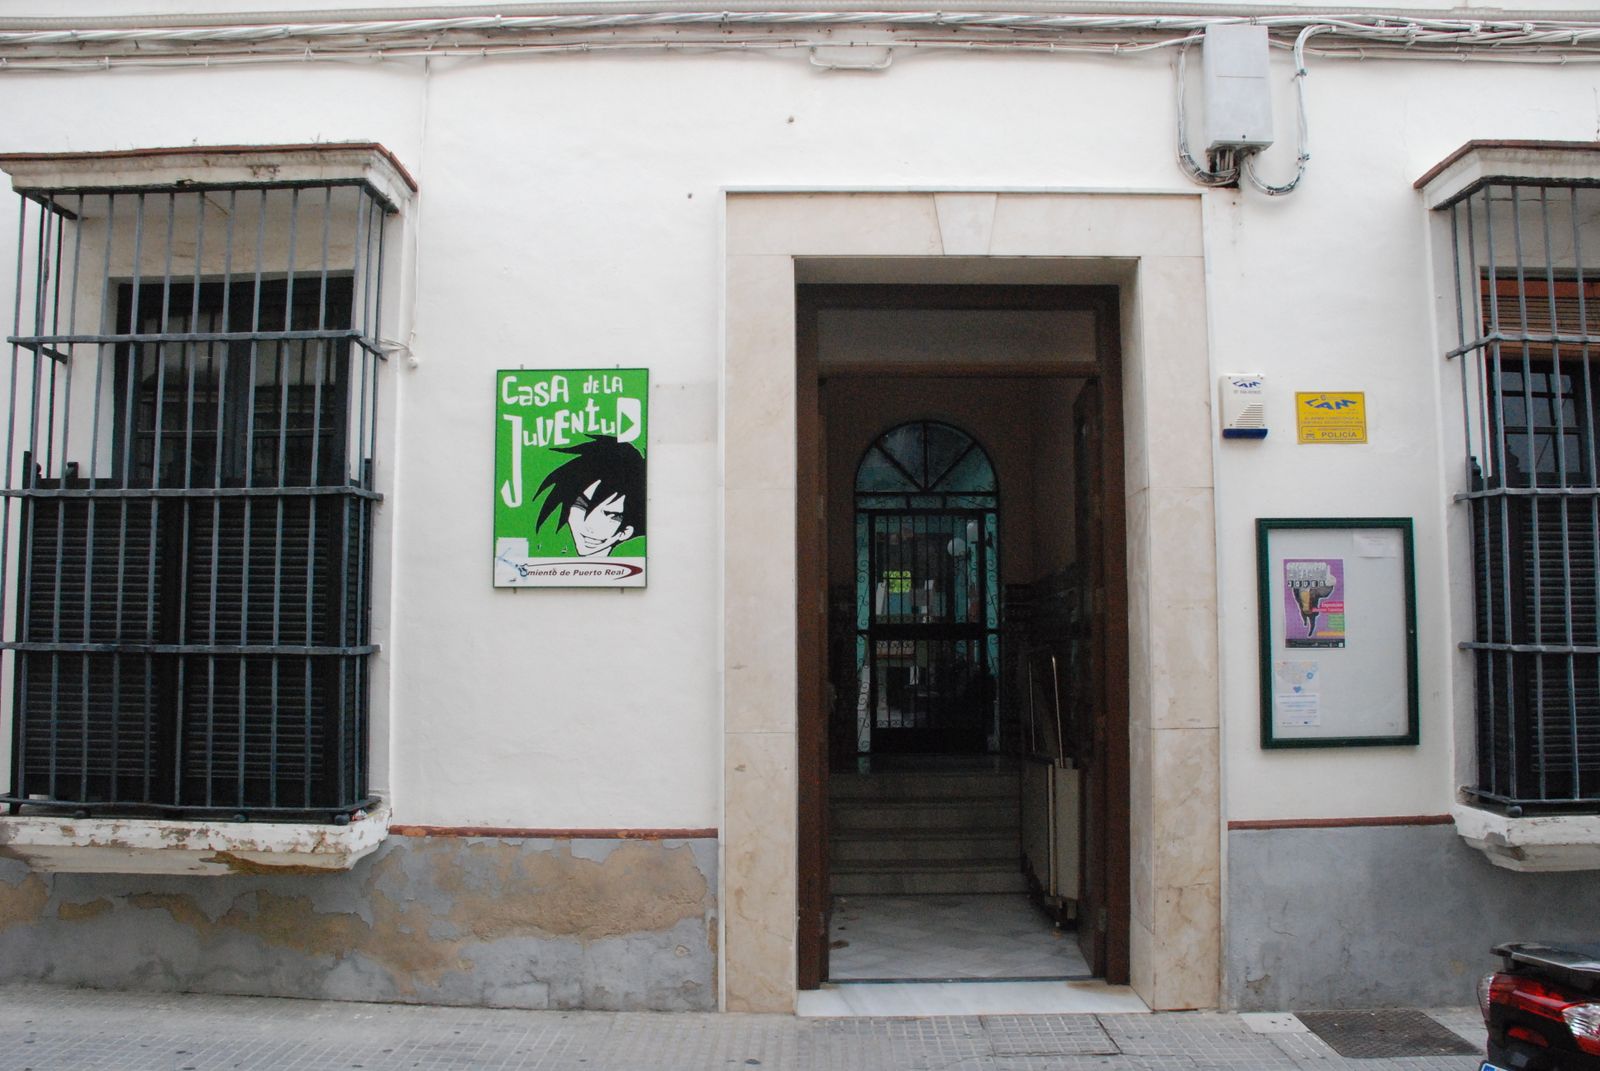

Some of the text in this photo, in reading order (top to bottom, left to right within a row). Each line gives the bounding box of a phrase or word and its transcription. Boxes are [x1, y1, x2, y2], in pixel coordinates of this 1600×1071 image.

[603, 375, 623, 394] LA
[527, 567, 625, 577] miento de Puerto Real
